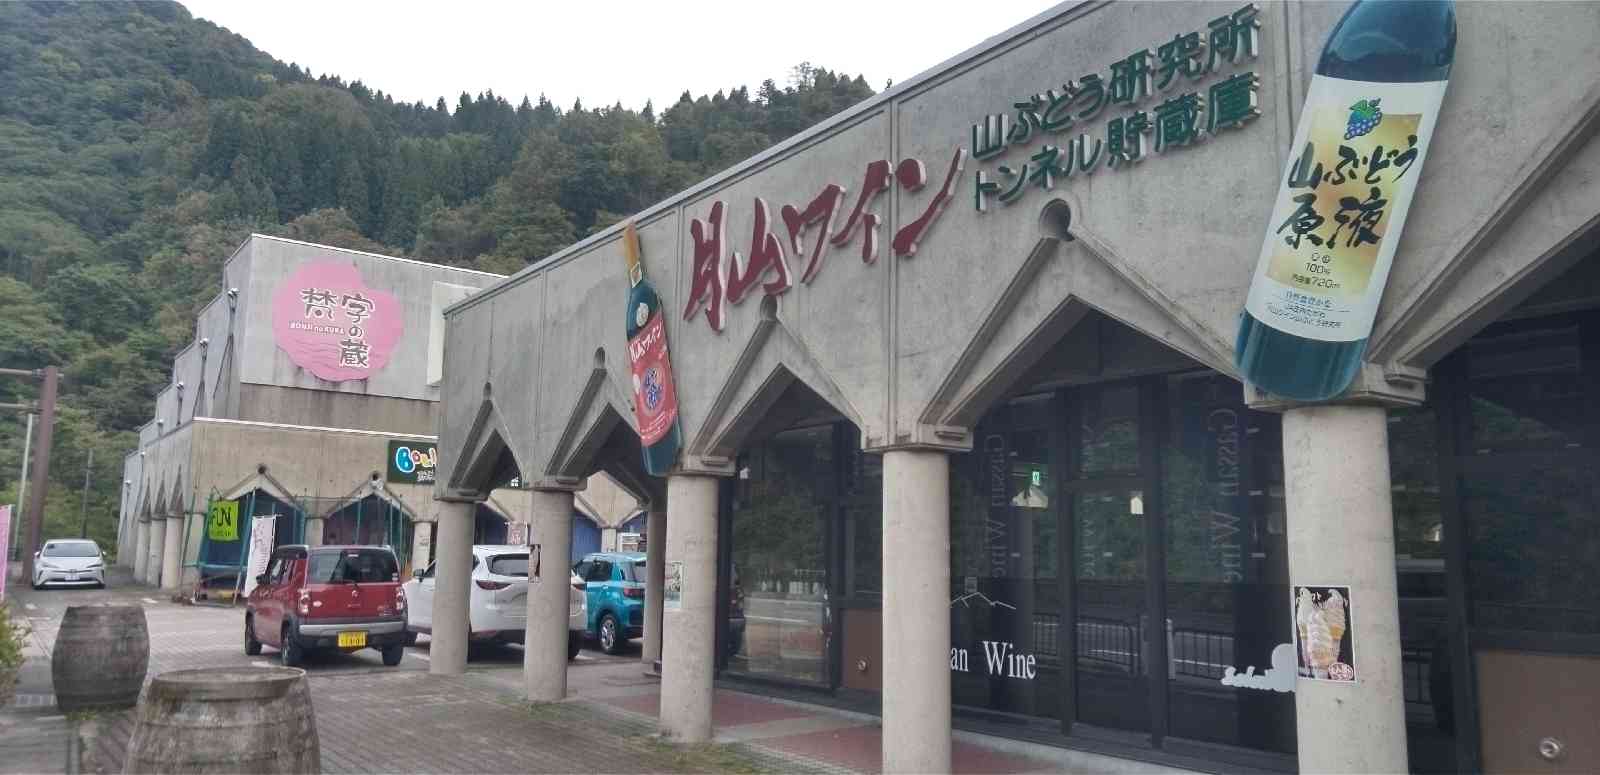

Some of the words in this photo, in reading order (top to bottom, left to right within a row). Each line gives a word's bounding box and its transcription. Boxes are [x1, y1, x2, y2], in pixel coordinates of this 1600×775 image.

[973, 3, 1261, 160] 山ぶどう研究所
[975, 72, 1262, 213] トンネル貯蔵庫
[1288, 134, 1418, 190] 山ぶどう
[683, 146, 967, 335] 月山ワイン
[1276, 186, 1389, 249] 原液
[301, 288, 375, 368] 梵字の蔵
[982, 640, 1037, 680] Wine
